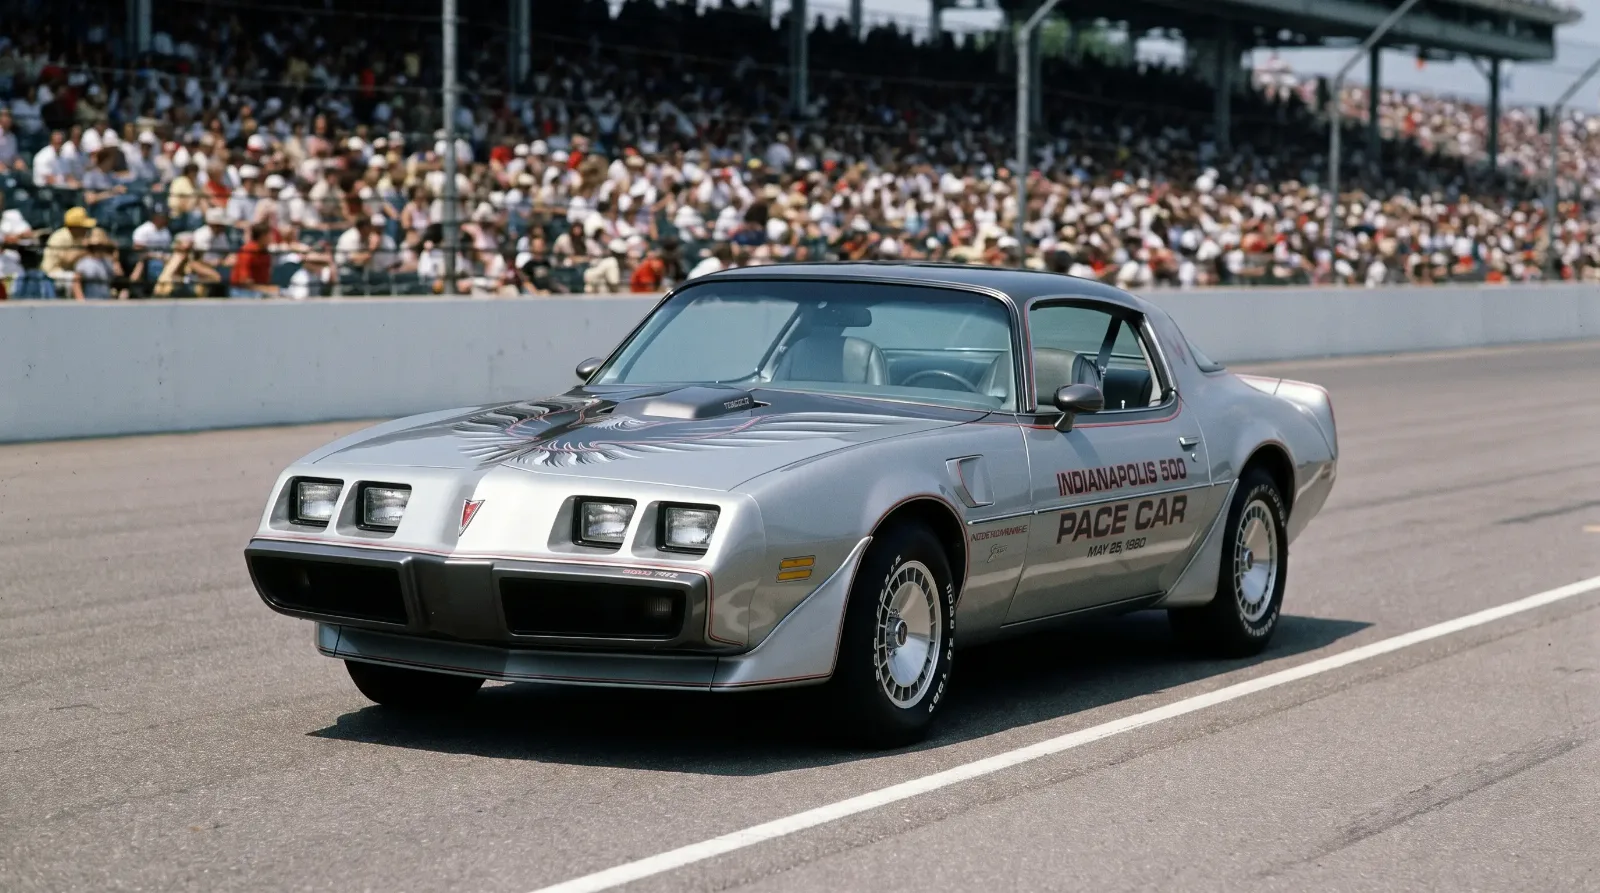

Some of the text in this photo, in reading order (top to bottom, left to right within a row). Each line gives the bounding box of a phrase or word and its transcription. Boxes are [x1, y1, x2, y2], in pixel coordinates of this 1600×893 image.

[1056, 457, 1187, 496] INDIANAPOLIS 500
[1056, 503, 1129, 545] PACE
[1134, 494, 1188, 531] CAR
[1087, 543, 1110, 558] MAY
[1125, 537, 1147, 551] 1980
